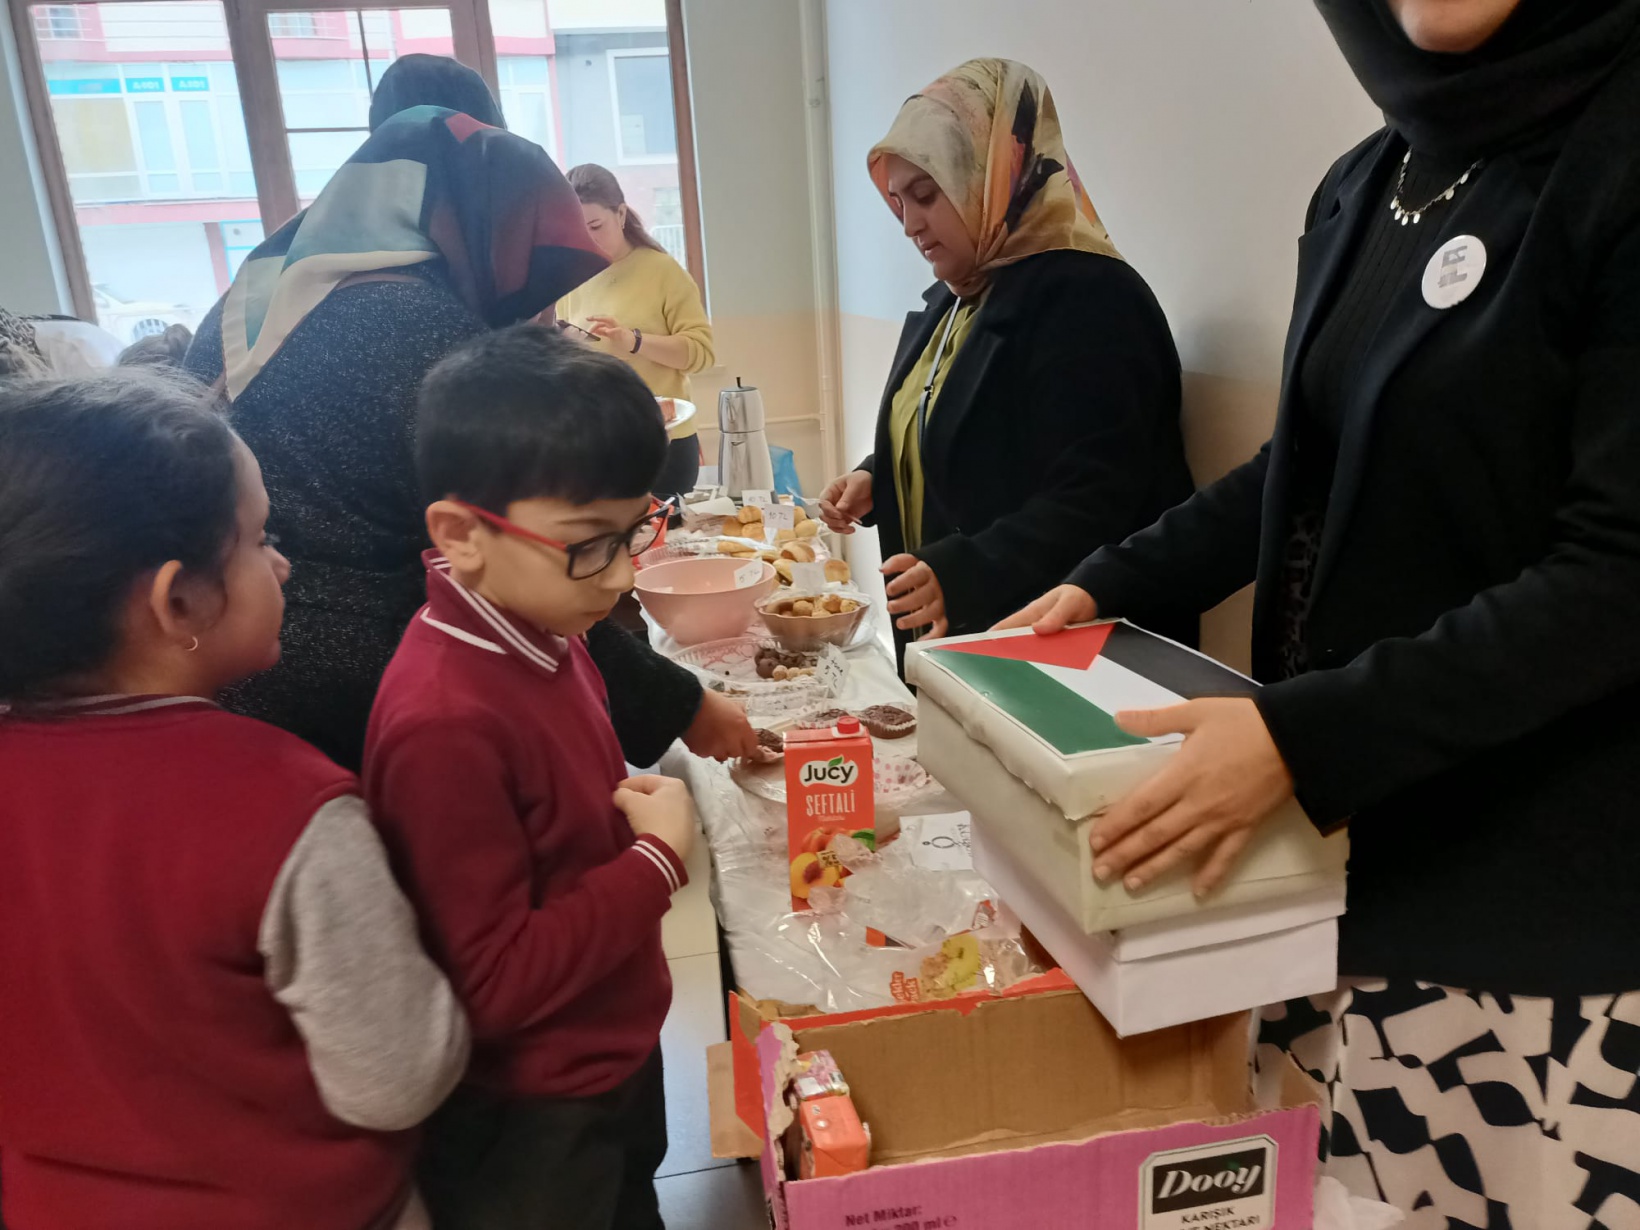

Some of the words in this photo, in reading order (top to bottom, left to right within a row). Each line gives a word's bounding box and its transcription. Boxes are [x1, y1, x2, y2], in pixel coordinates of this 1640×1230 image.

[804, 764, 854, 784] Jucy
[1157, 1164, 1262, 1199] Dooy
[845, 1213, 869, 1227] Net
